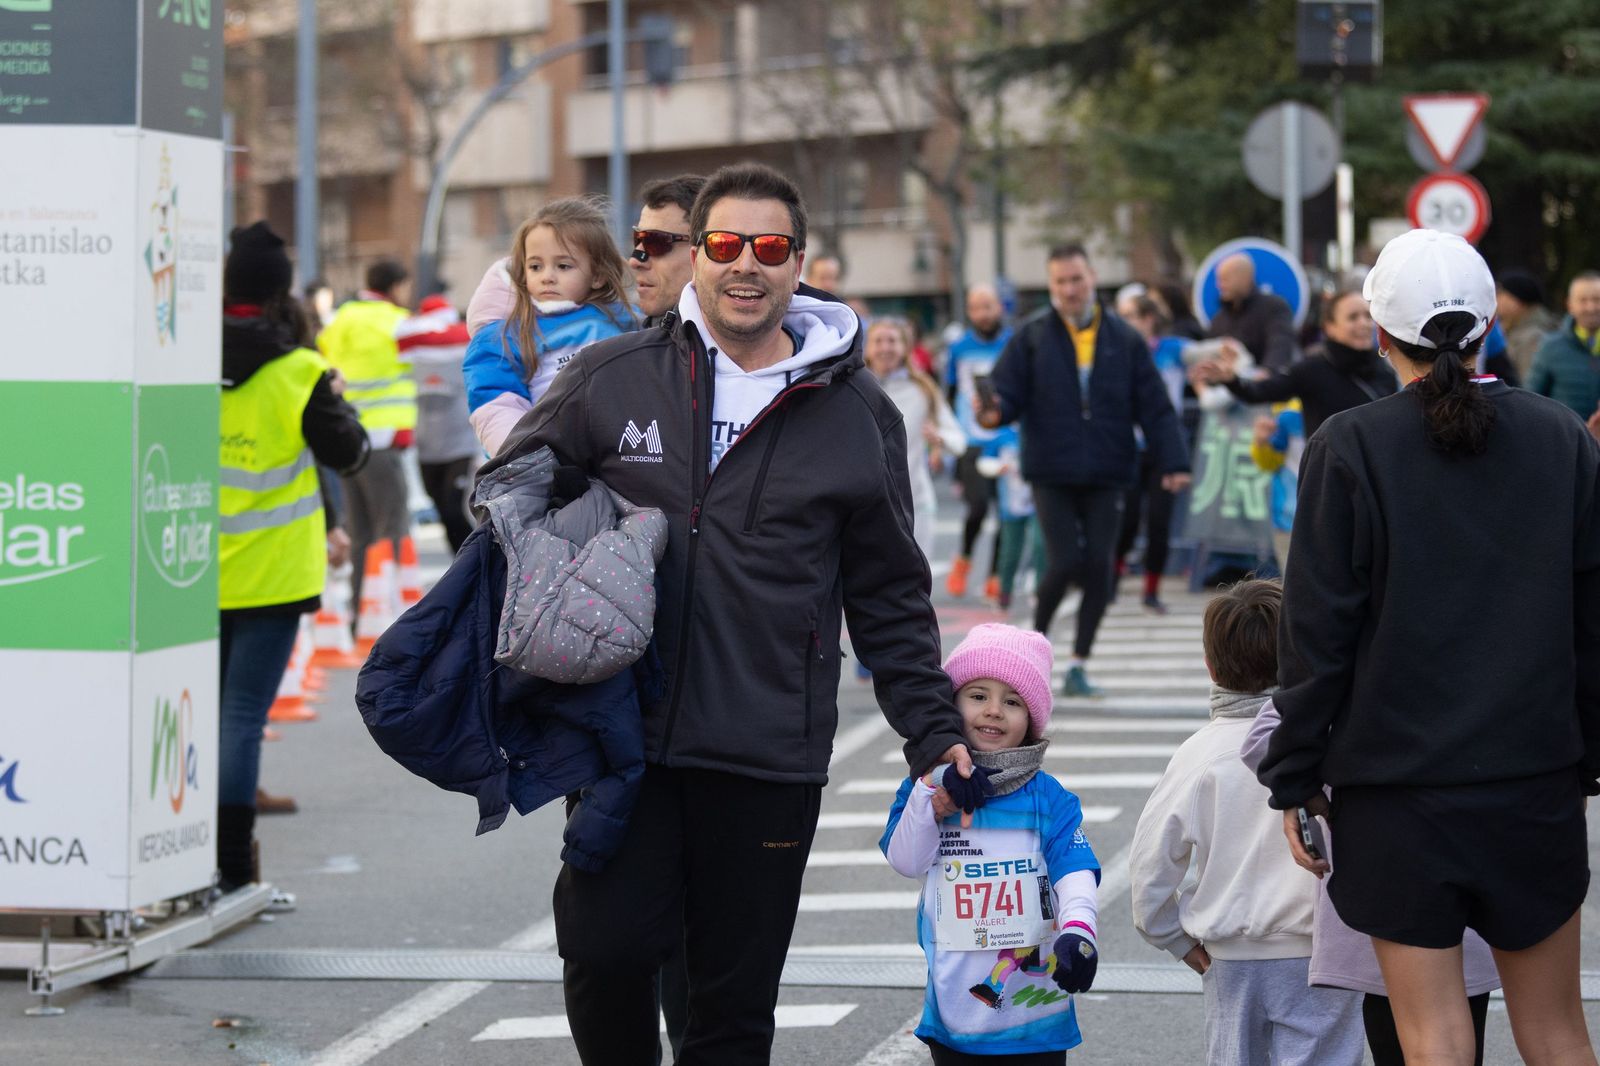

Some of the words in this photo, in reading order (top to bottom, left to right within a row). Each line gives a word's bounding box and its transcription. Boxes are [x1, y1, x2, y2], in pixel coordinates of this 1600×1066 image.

[0, 227, 112, 254] tanislao
[0, 259, 47, 285] tka
[1433, 300, 1449, 309] EST.
[620, 455, 663, 463] MULTICOCINAS
[162, 512, 177, 566] el
[964, 858, 1038, 879] SETEL
[954, 879, 1024, 920] 6741
[989, 931, 1025, 940] Ayuntamiento
[999, 938, 1025, 947] Salamanca
